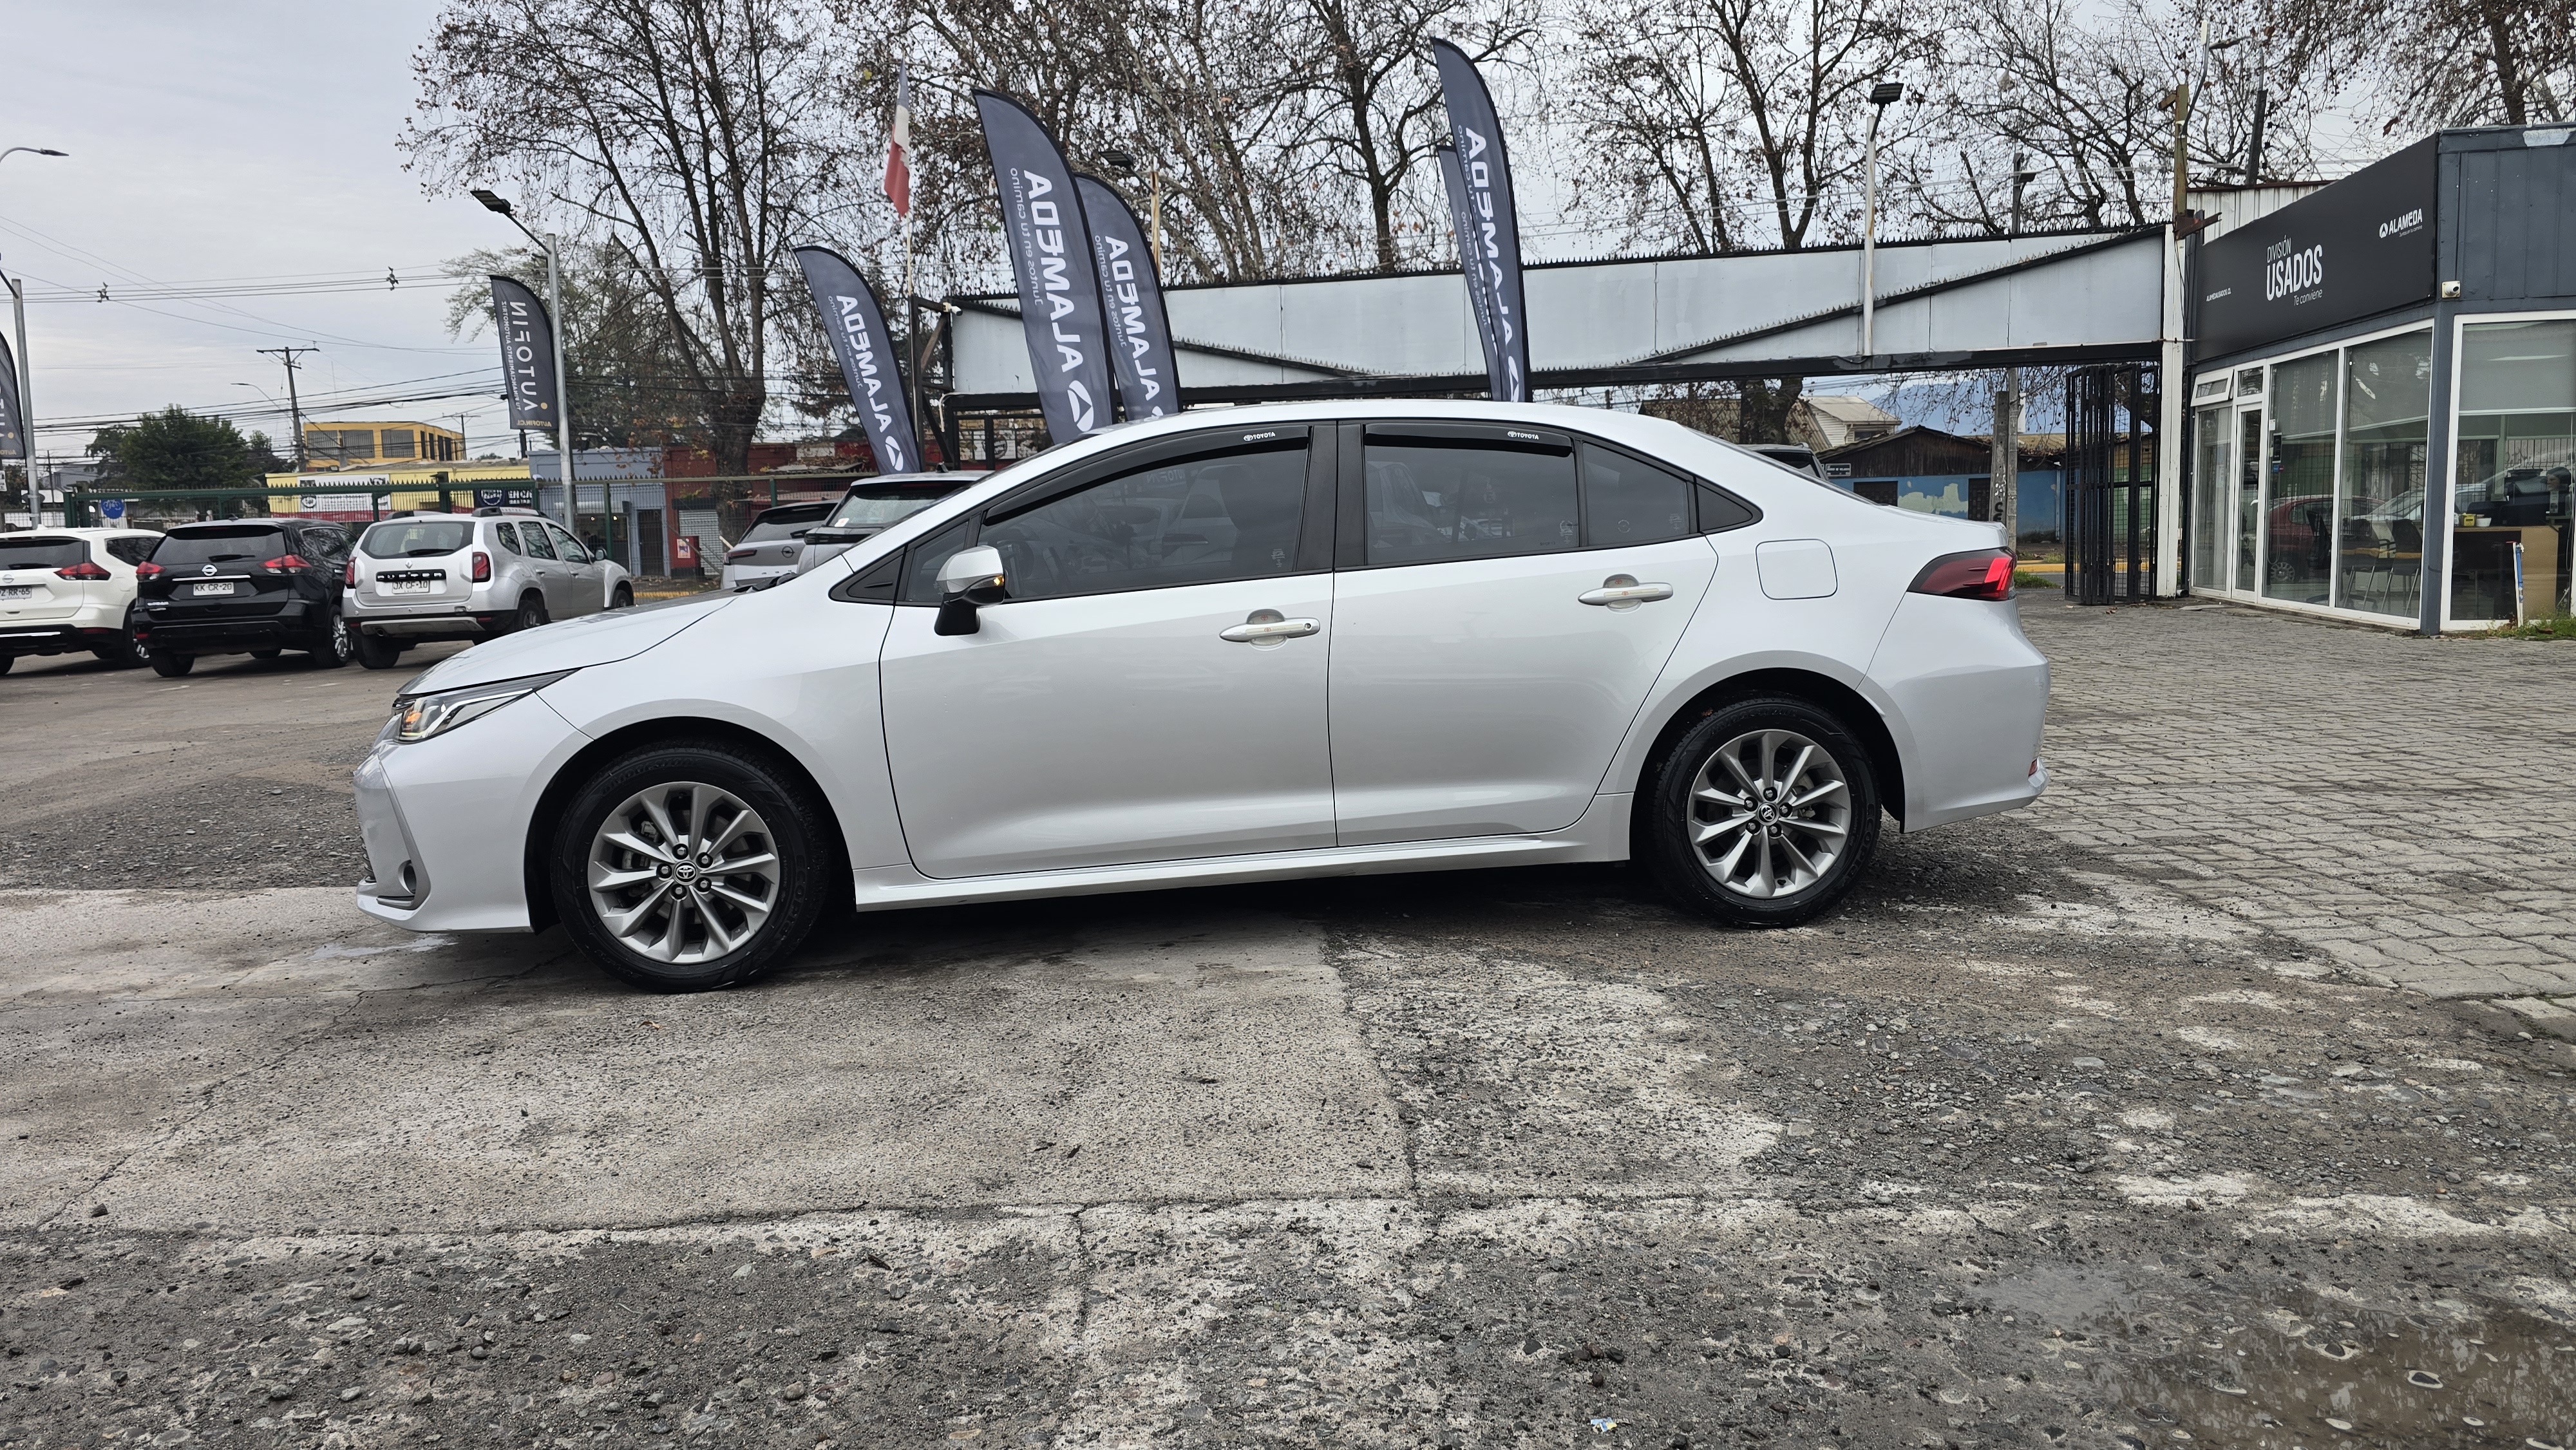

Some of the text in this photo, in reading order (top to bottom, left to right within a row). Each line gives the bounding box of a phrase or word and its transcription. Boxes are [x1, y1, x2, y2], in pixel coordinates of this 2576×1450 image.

[2389, 209, 2422, 235] ALAMEDA
[2267, 234, 2291, 263] DIVISIÓN
[2266, 244, 2323, 301] USADOS
[2294, 288, 2323, 306] Te conviene
